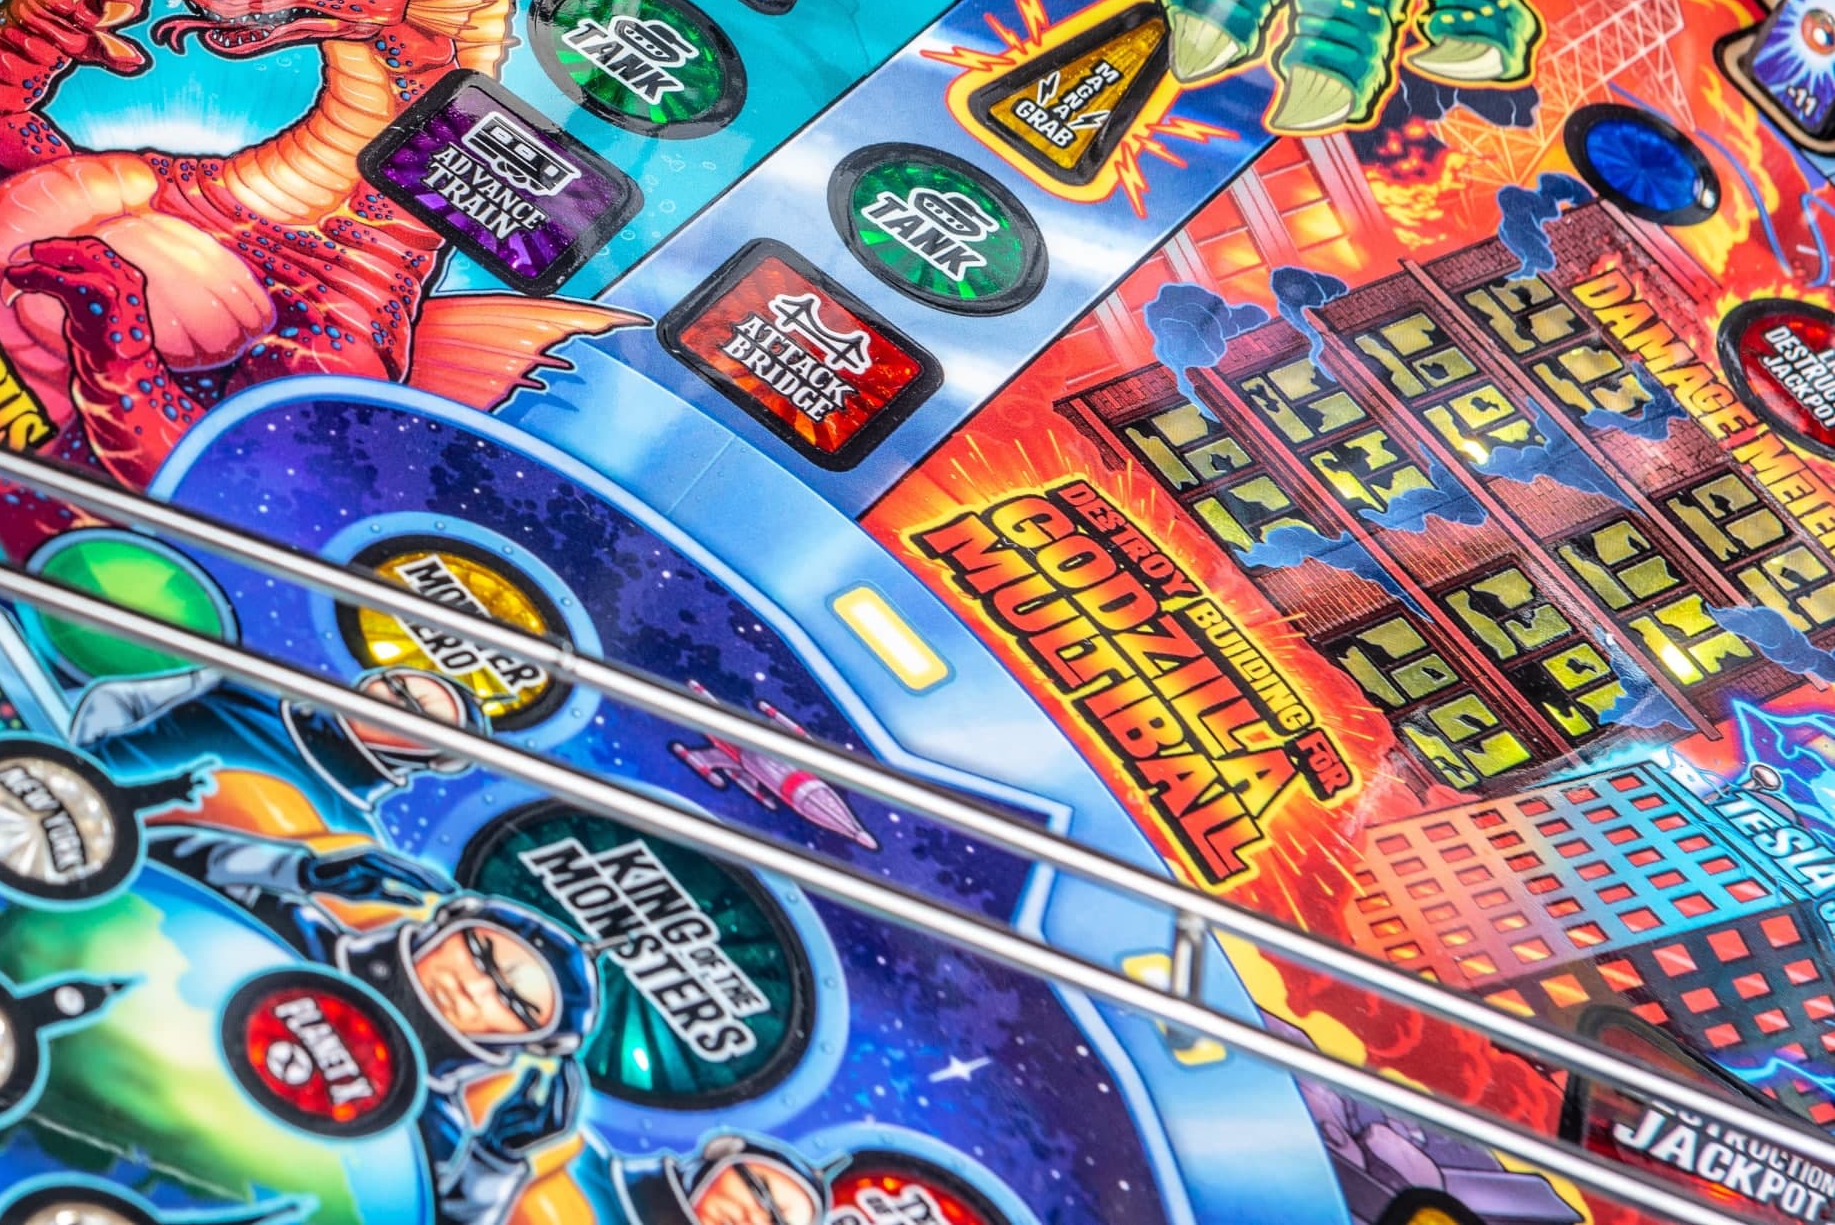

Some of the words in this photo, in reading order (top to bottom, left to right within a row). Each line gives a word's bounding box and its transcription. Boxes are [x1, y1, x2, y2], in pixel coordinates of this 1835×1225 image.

[565, 19, 683, 104] TANK
[1052, 61, 1121, 121] MAGNA
[1786, 85, 1818, 118] -11
[1014, 99, 1075, 148] GRAB
[423, 161, 522, 241] TRAIN
[431, 146, 548, 231] ADVANCE
[865, 193, 984, 280] TANK
[720, 335, 834, 423] BRIDGE
[735, 314, 856, 409] ATTACK
[1571, 268, 1761, 441] DAMAGE
[1731, 430, 1835, 561] METE
[989, 495, 1301, 820] GODZILLA
[1056, 483, 1200, 599] DESTROY
[1189, 601, 1316, 735] BUILDING
[1293, 730, 1354, 796] FOR
[920, 514, 1265, 883] MULTIBALL
[597, 846, 713, 946] KING
[528, 845, 749, 1053] MONSTERS
[274, 996, 361, 1082] PLANET
[329, 1076, 374, 1106] X
[1611, 1108, 1829, 1221] JACKPOT
